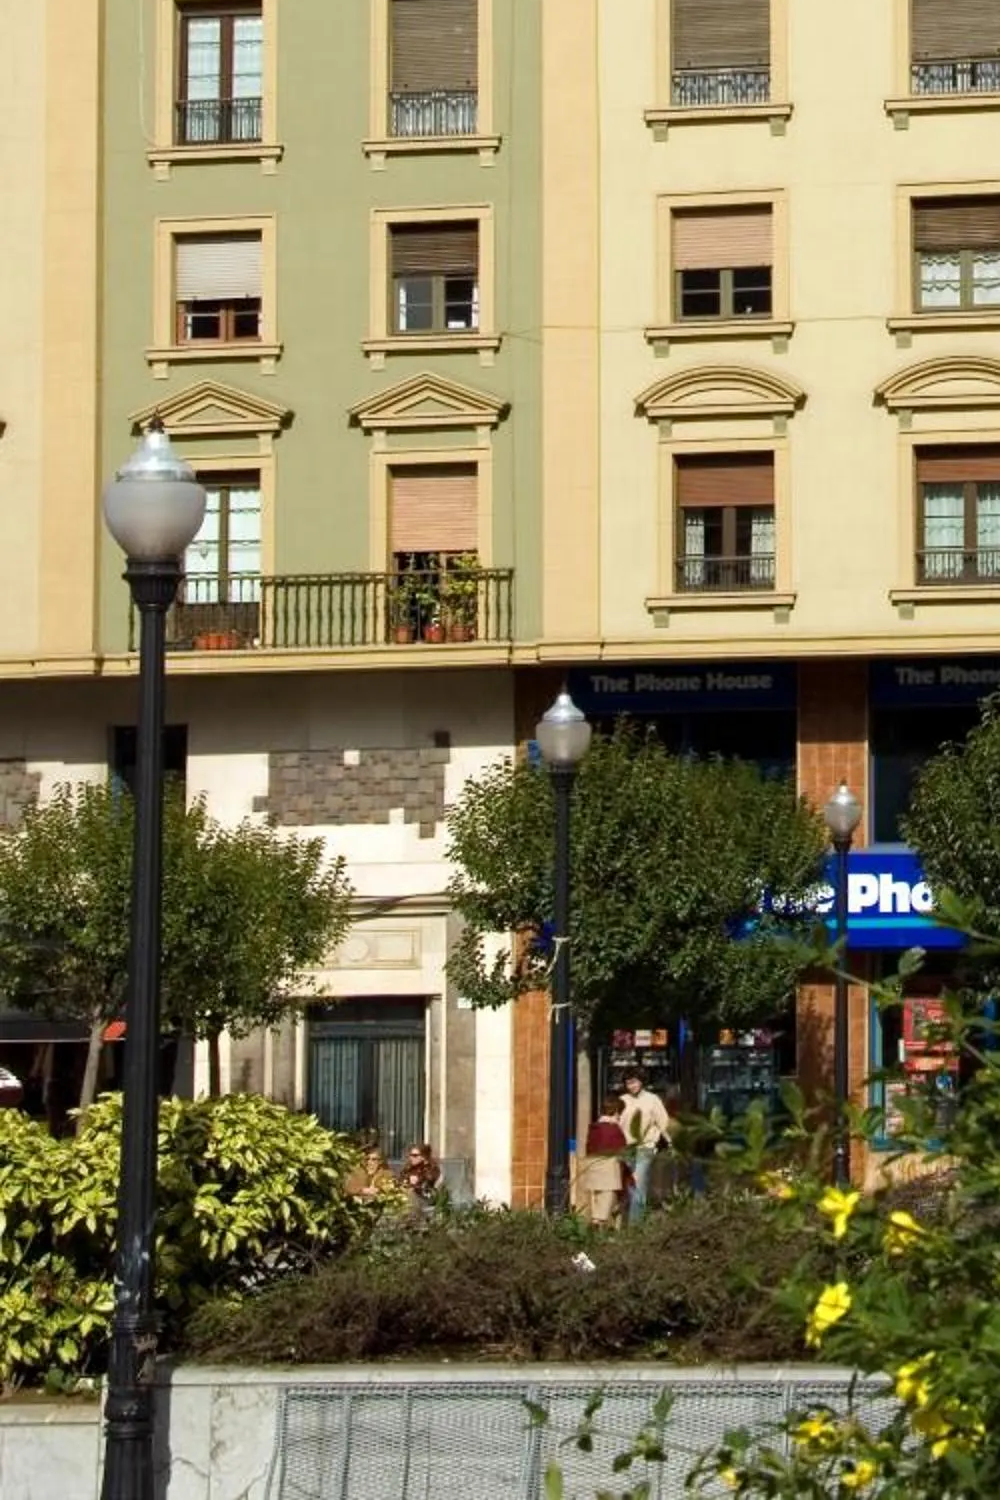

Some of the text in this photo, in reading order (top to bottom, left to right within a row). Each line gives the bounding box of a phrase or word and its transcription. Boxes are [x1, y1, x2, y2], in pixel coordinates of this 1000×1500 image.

[590, 671, 775, 693] The Phone House
[895, 667, 935, 685] The
[848, 873, 935, 913] Pho
